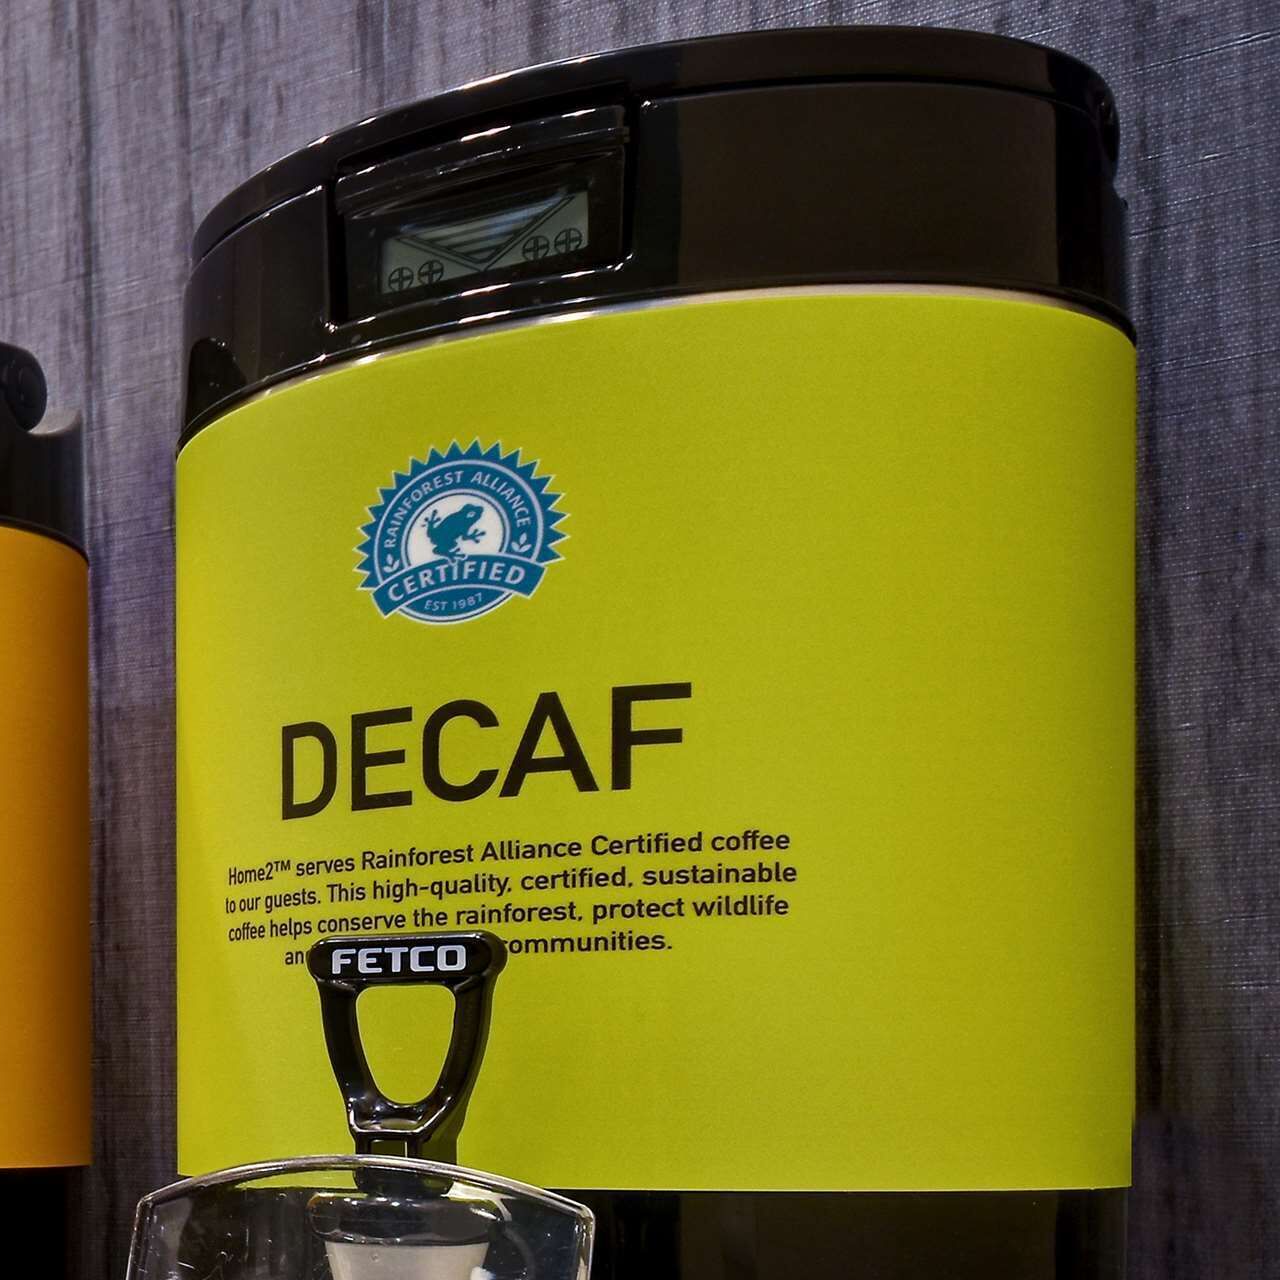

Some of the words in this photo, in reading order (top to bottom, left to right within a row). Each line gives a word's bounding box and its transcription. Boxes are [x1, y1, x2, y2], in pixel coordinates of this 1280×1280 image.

[383, 471, 464, 548] RAINFOREST
[471, 471, 532, 527] ALLIANCE
[387, 560, 526, 602] CERTIFIED
[423, 599, 448, 612] EST
[452, 592, 484, 611] 1987
[281, 682, 692, 821] DECAF
[296, 857, 355, 877] serves
[362, 844, 474, 870] Rainforest
[480, 840, 582, 862] Alliance
[591, 832, 703, 856] Certified
[711, 830, 790, 852] coffee
[226, 898, 236, 914] to
[239, 896, 261, 913] our
[265, 888, 321, 913] guests.
[326, 883, 366, 903] This
[373, 872, 513, 903] high-quality,
[520, 866, 633, 891] certified,
[642, 862, 797, 886] sustainable
[228, 922, 265, 942] coffee
[270, 917, 312, 941] helps
[318, 912, 406, 934] conserve
[413, 907, 448, 927] the
[456, 901, 583, 925] rainforest,
[592, 897, 684, 924] protect
[692, 894, 789, 917] wildlife
[285, 949, 304, 965] an
[331, 944, 466, 975] FETCO
